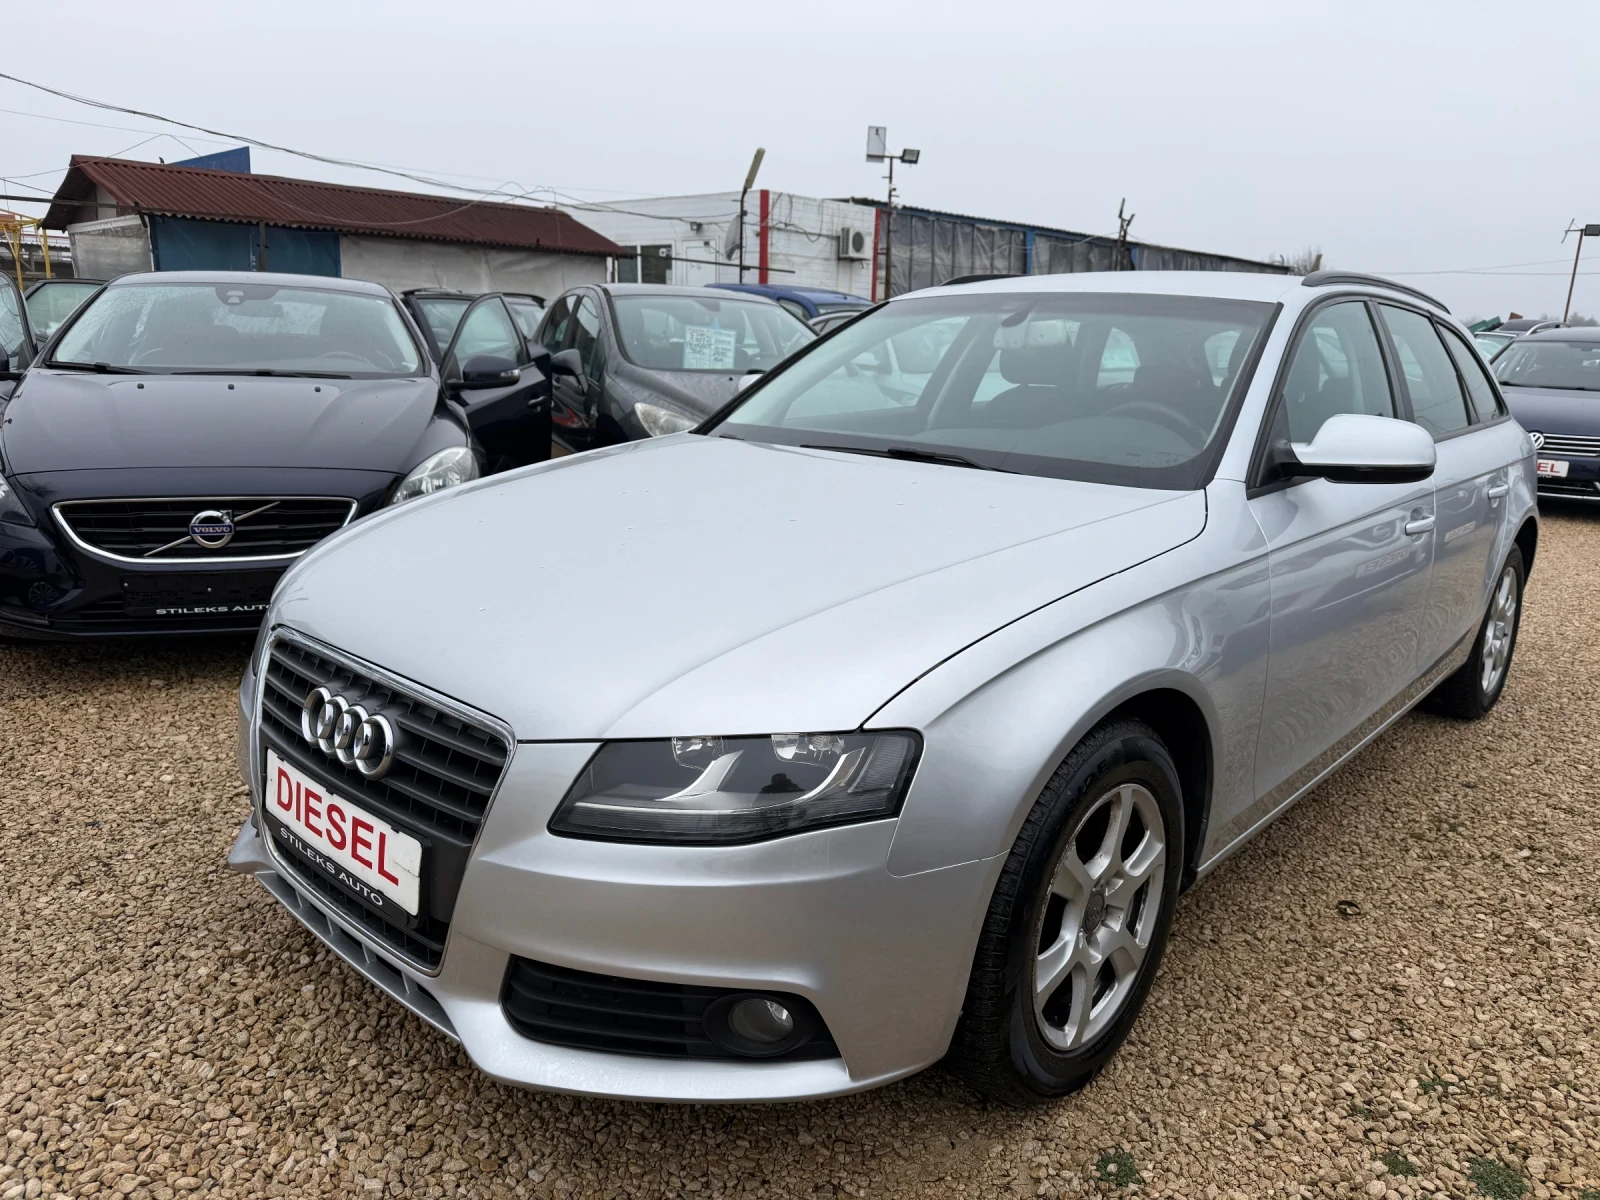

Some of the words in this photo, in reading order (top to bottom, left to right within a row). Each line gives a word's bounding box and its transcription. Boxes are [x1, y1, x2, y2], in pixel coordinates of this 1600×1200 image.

[155, 606, 229, 615] STILEKS
[277, 766, 399, 887] DIESEL
[280, 827, 335, 874] STILEKS
[339, 872, 383, 906] AUTO
